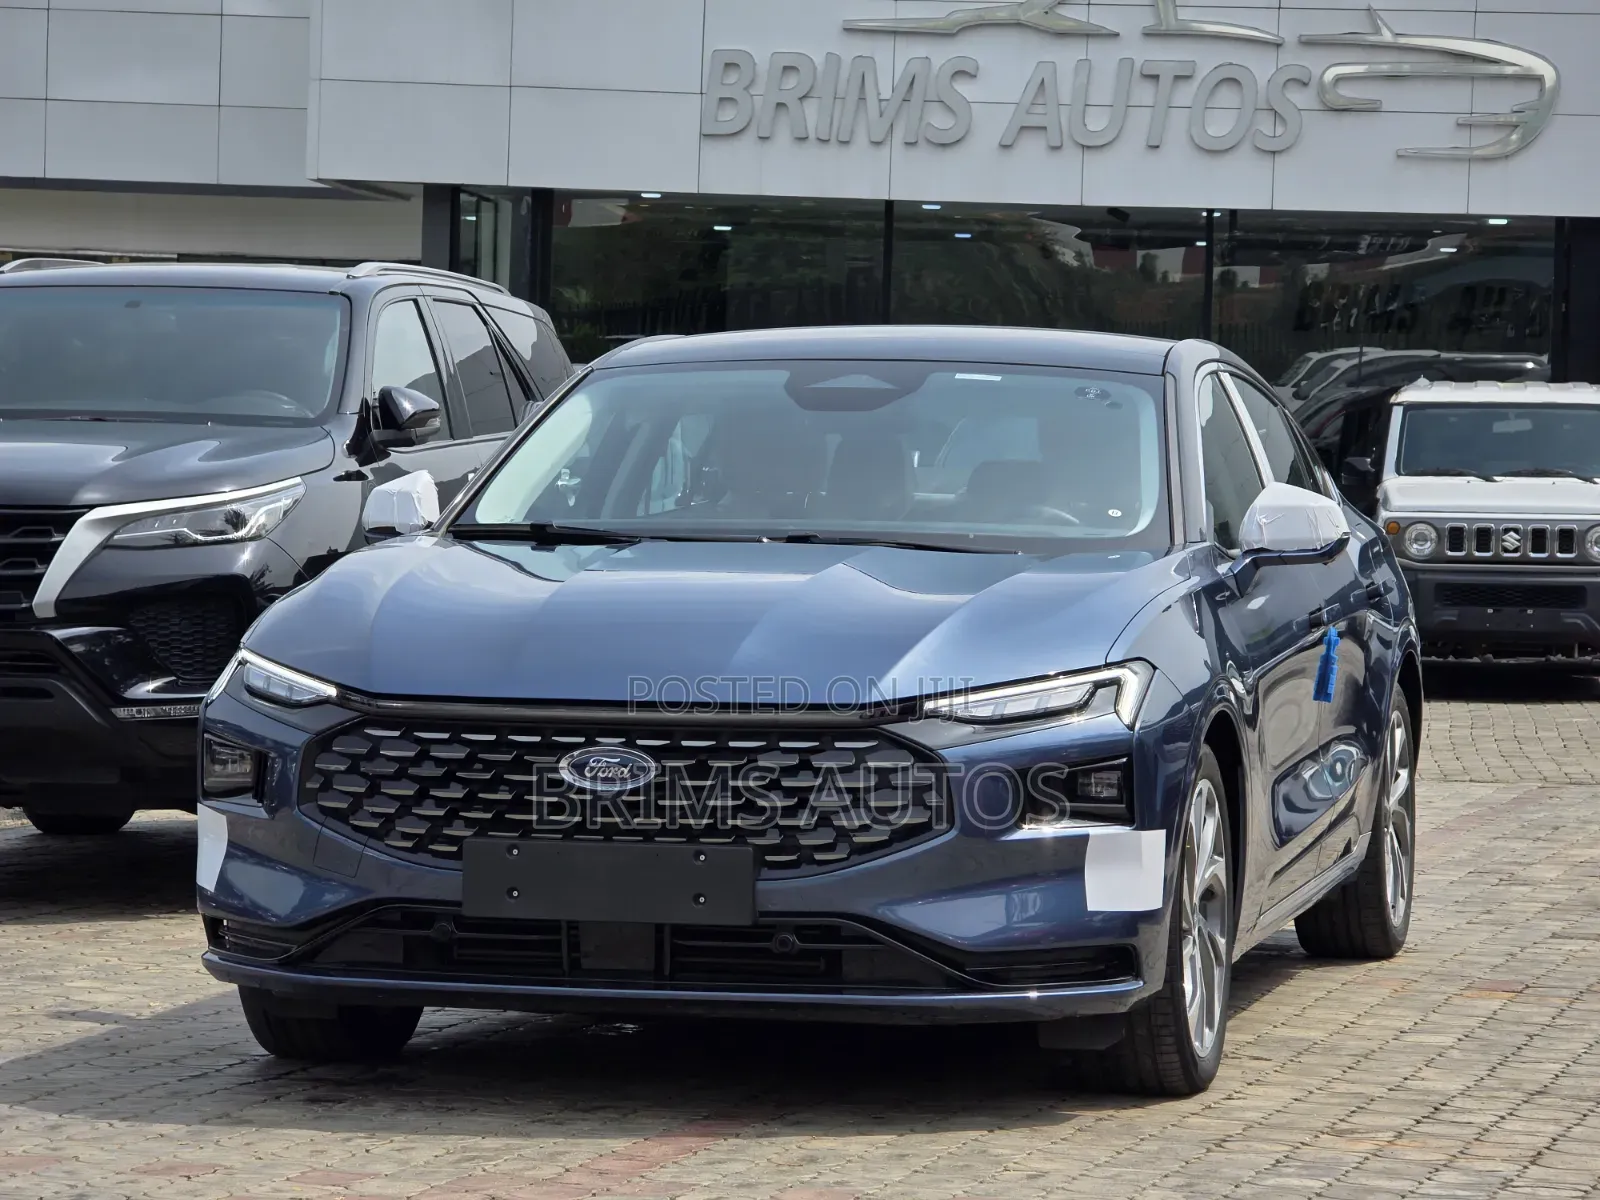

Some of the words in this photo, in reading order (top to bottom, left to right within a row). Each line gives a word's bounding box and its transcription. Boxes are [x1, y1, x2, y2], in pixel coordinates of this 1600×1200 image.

[700, 49, 979, 145] BRIMS
[999, 57, 1312, 153] AUTOS
[584, 756, 633, 779] Ford
